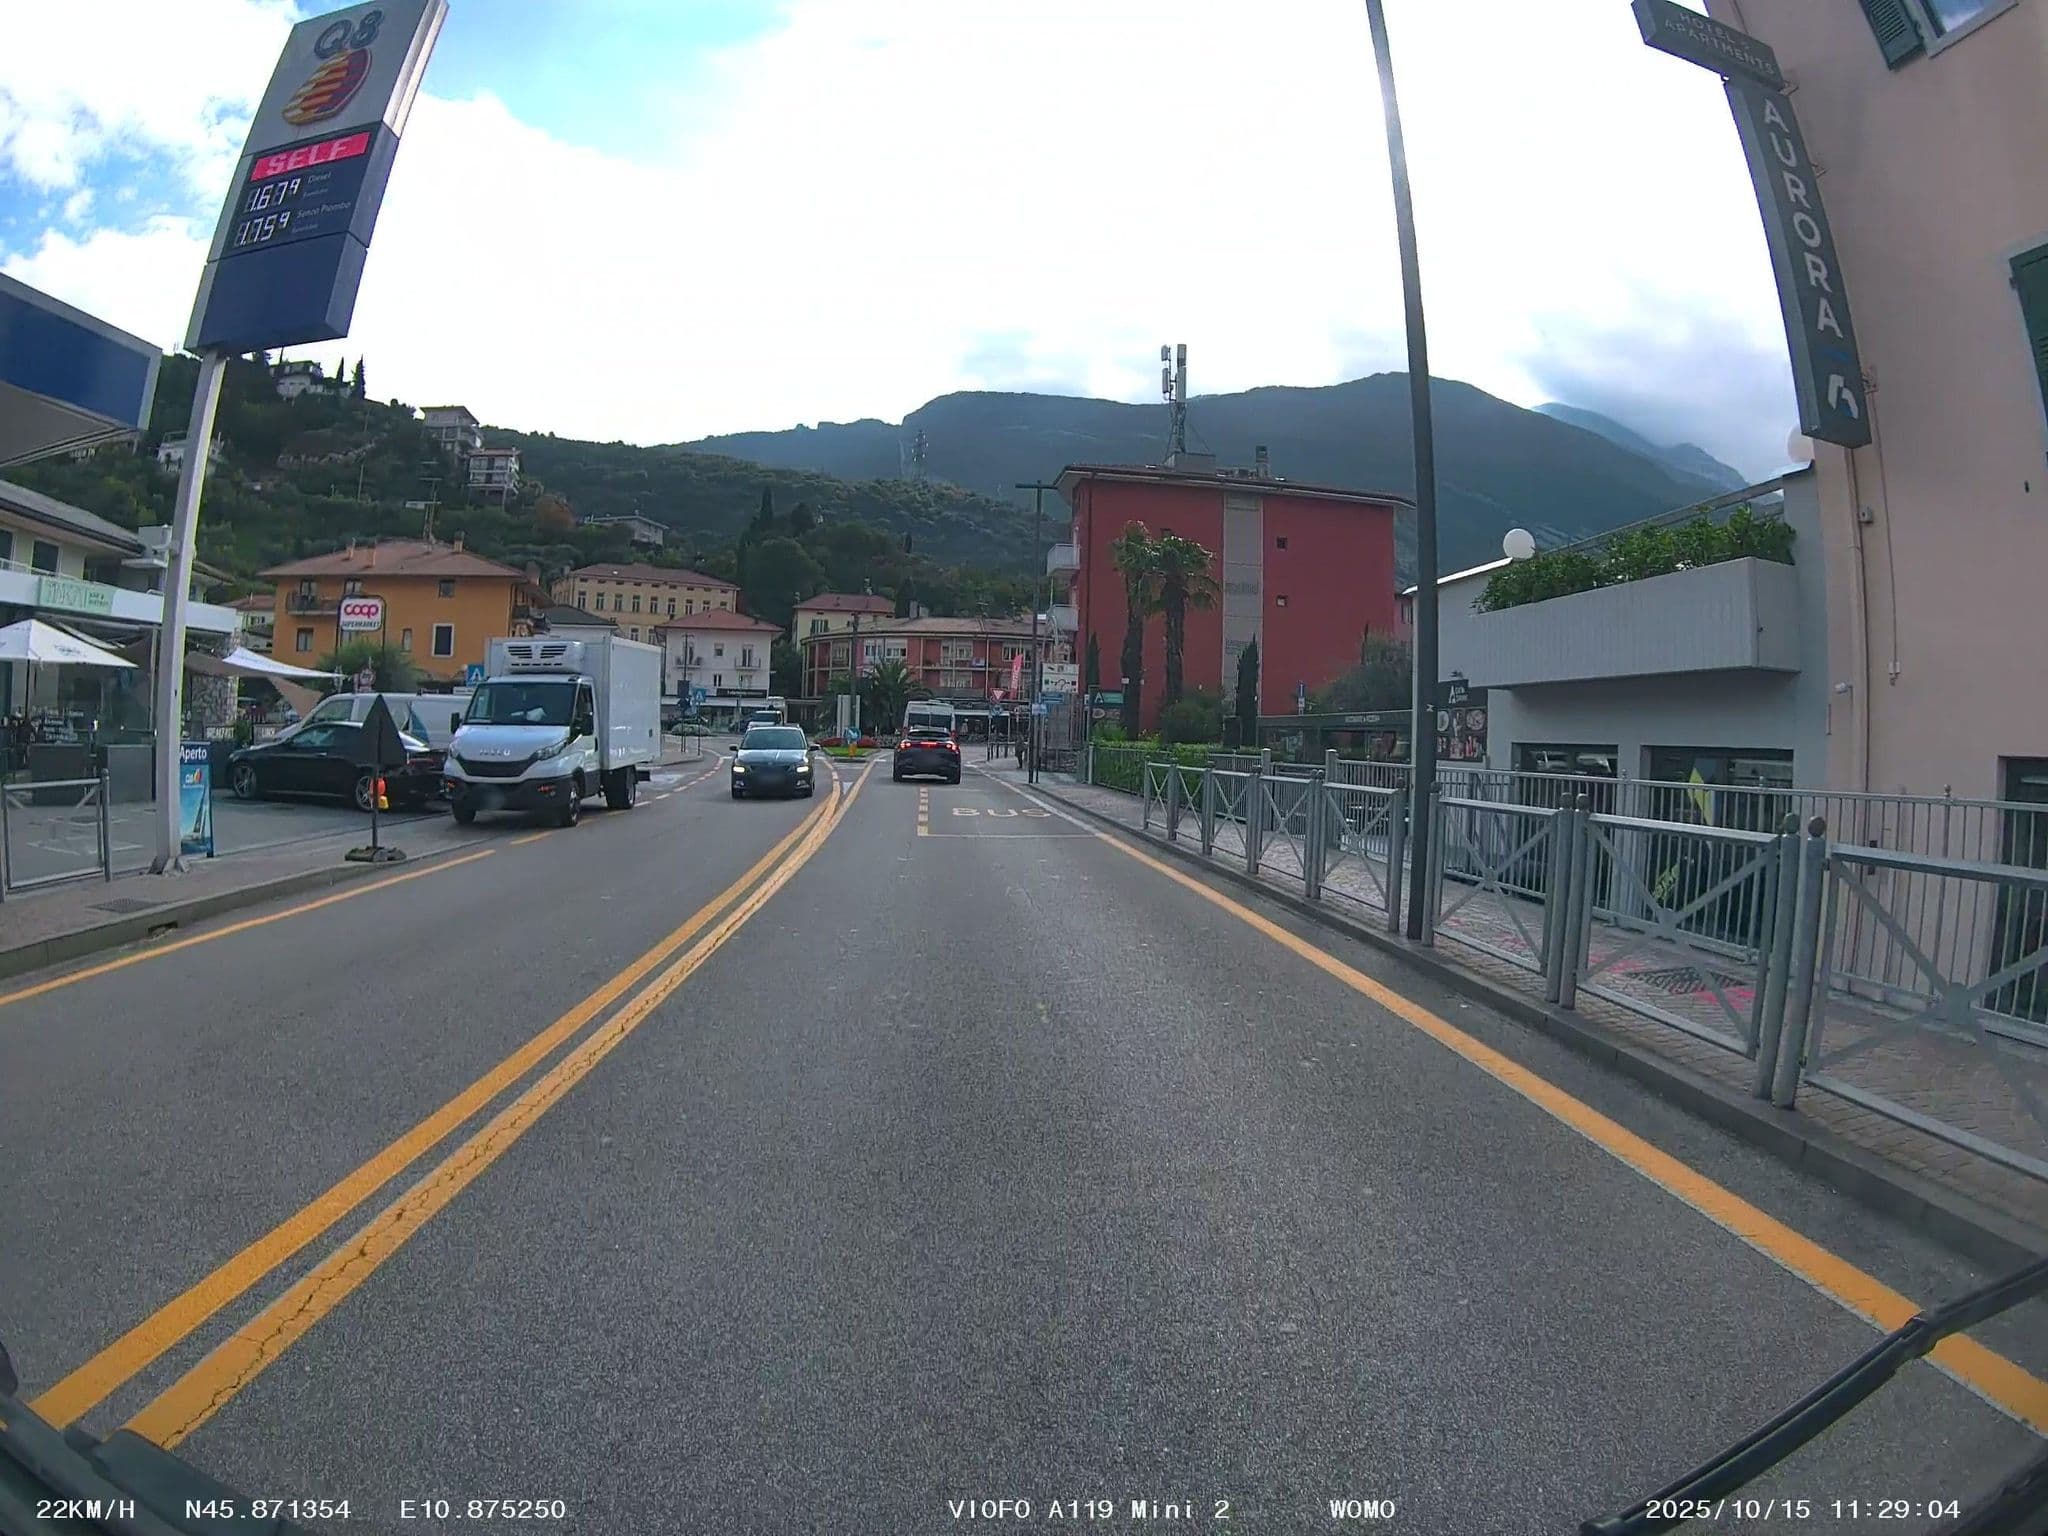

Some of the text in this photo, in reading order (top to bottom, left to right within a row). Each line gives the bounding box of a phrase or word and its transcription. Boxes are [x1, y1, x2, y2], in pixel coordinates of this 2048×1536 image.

[314, 9, 384, 58] Q8
[1665, 18, 1776, 75] APARTMENTS
[1680, 13, 1735, 43] HOTEL
[266, 136, 353, 175] SELF
[1763, 97, 1844, 340] AURORA
[180, 745, 208, 763] Aperto
[952, 807, 1052, 818] BUS
